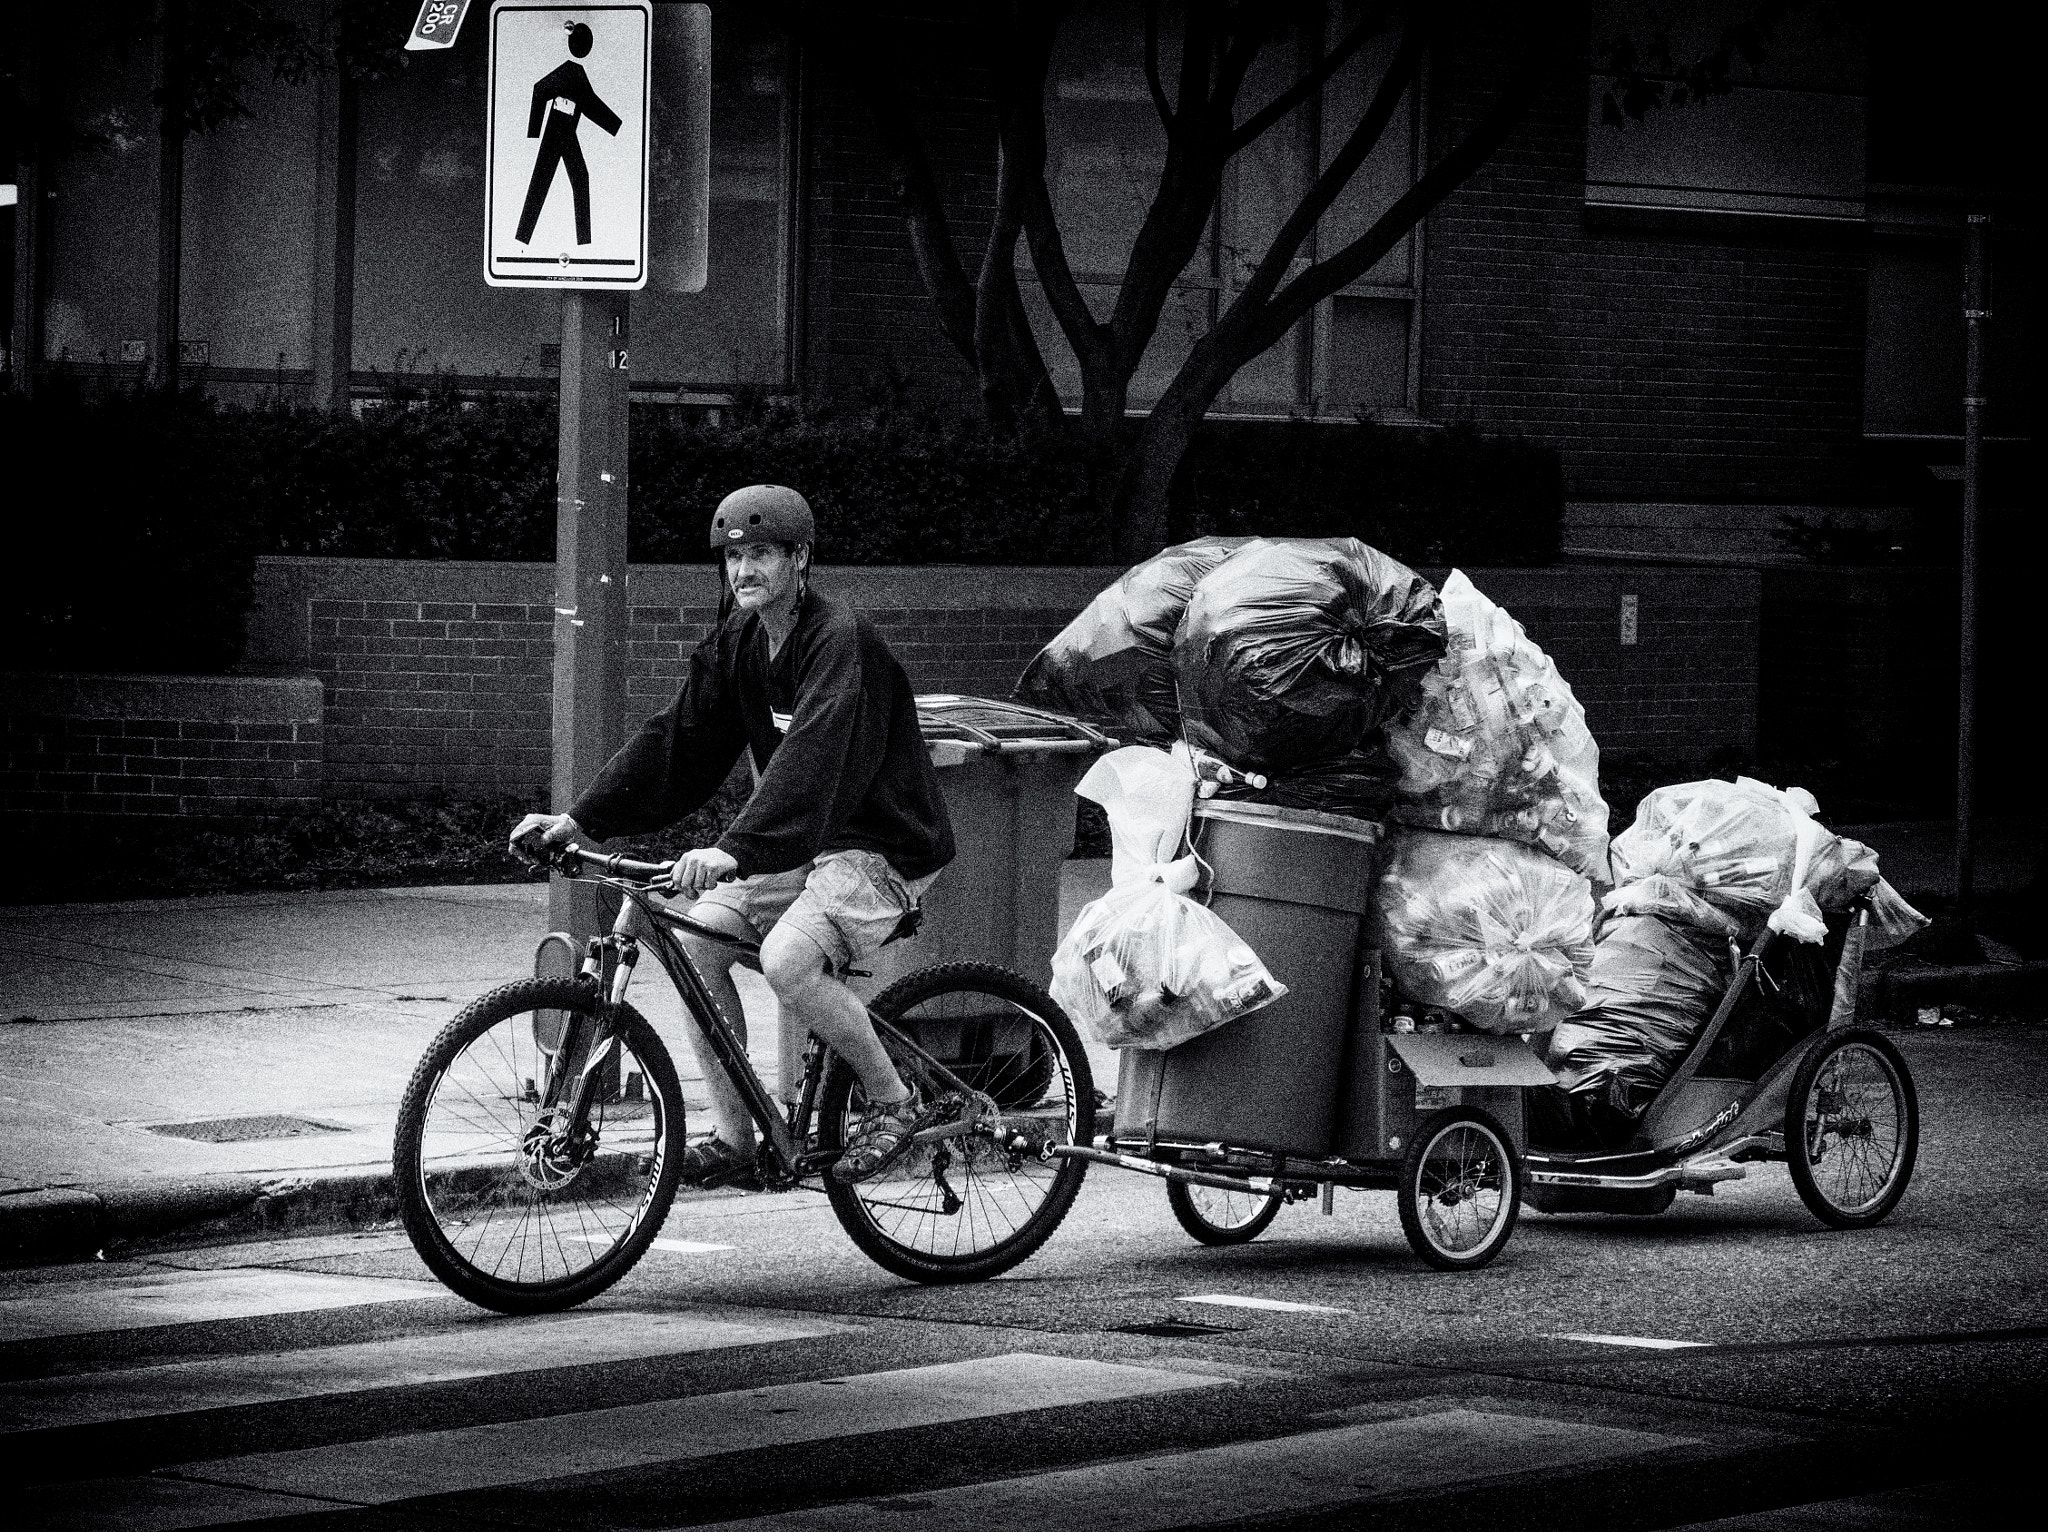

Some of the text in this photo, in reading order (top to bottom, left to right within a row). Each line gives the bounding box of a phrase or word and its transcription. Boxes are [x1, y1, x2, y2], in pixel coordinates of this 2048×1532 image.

[421, 0, 446, 34] 200
[438, 4, 458, 25] CR
[611, 350, 628, 369] 12
